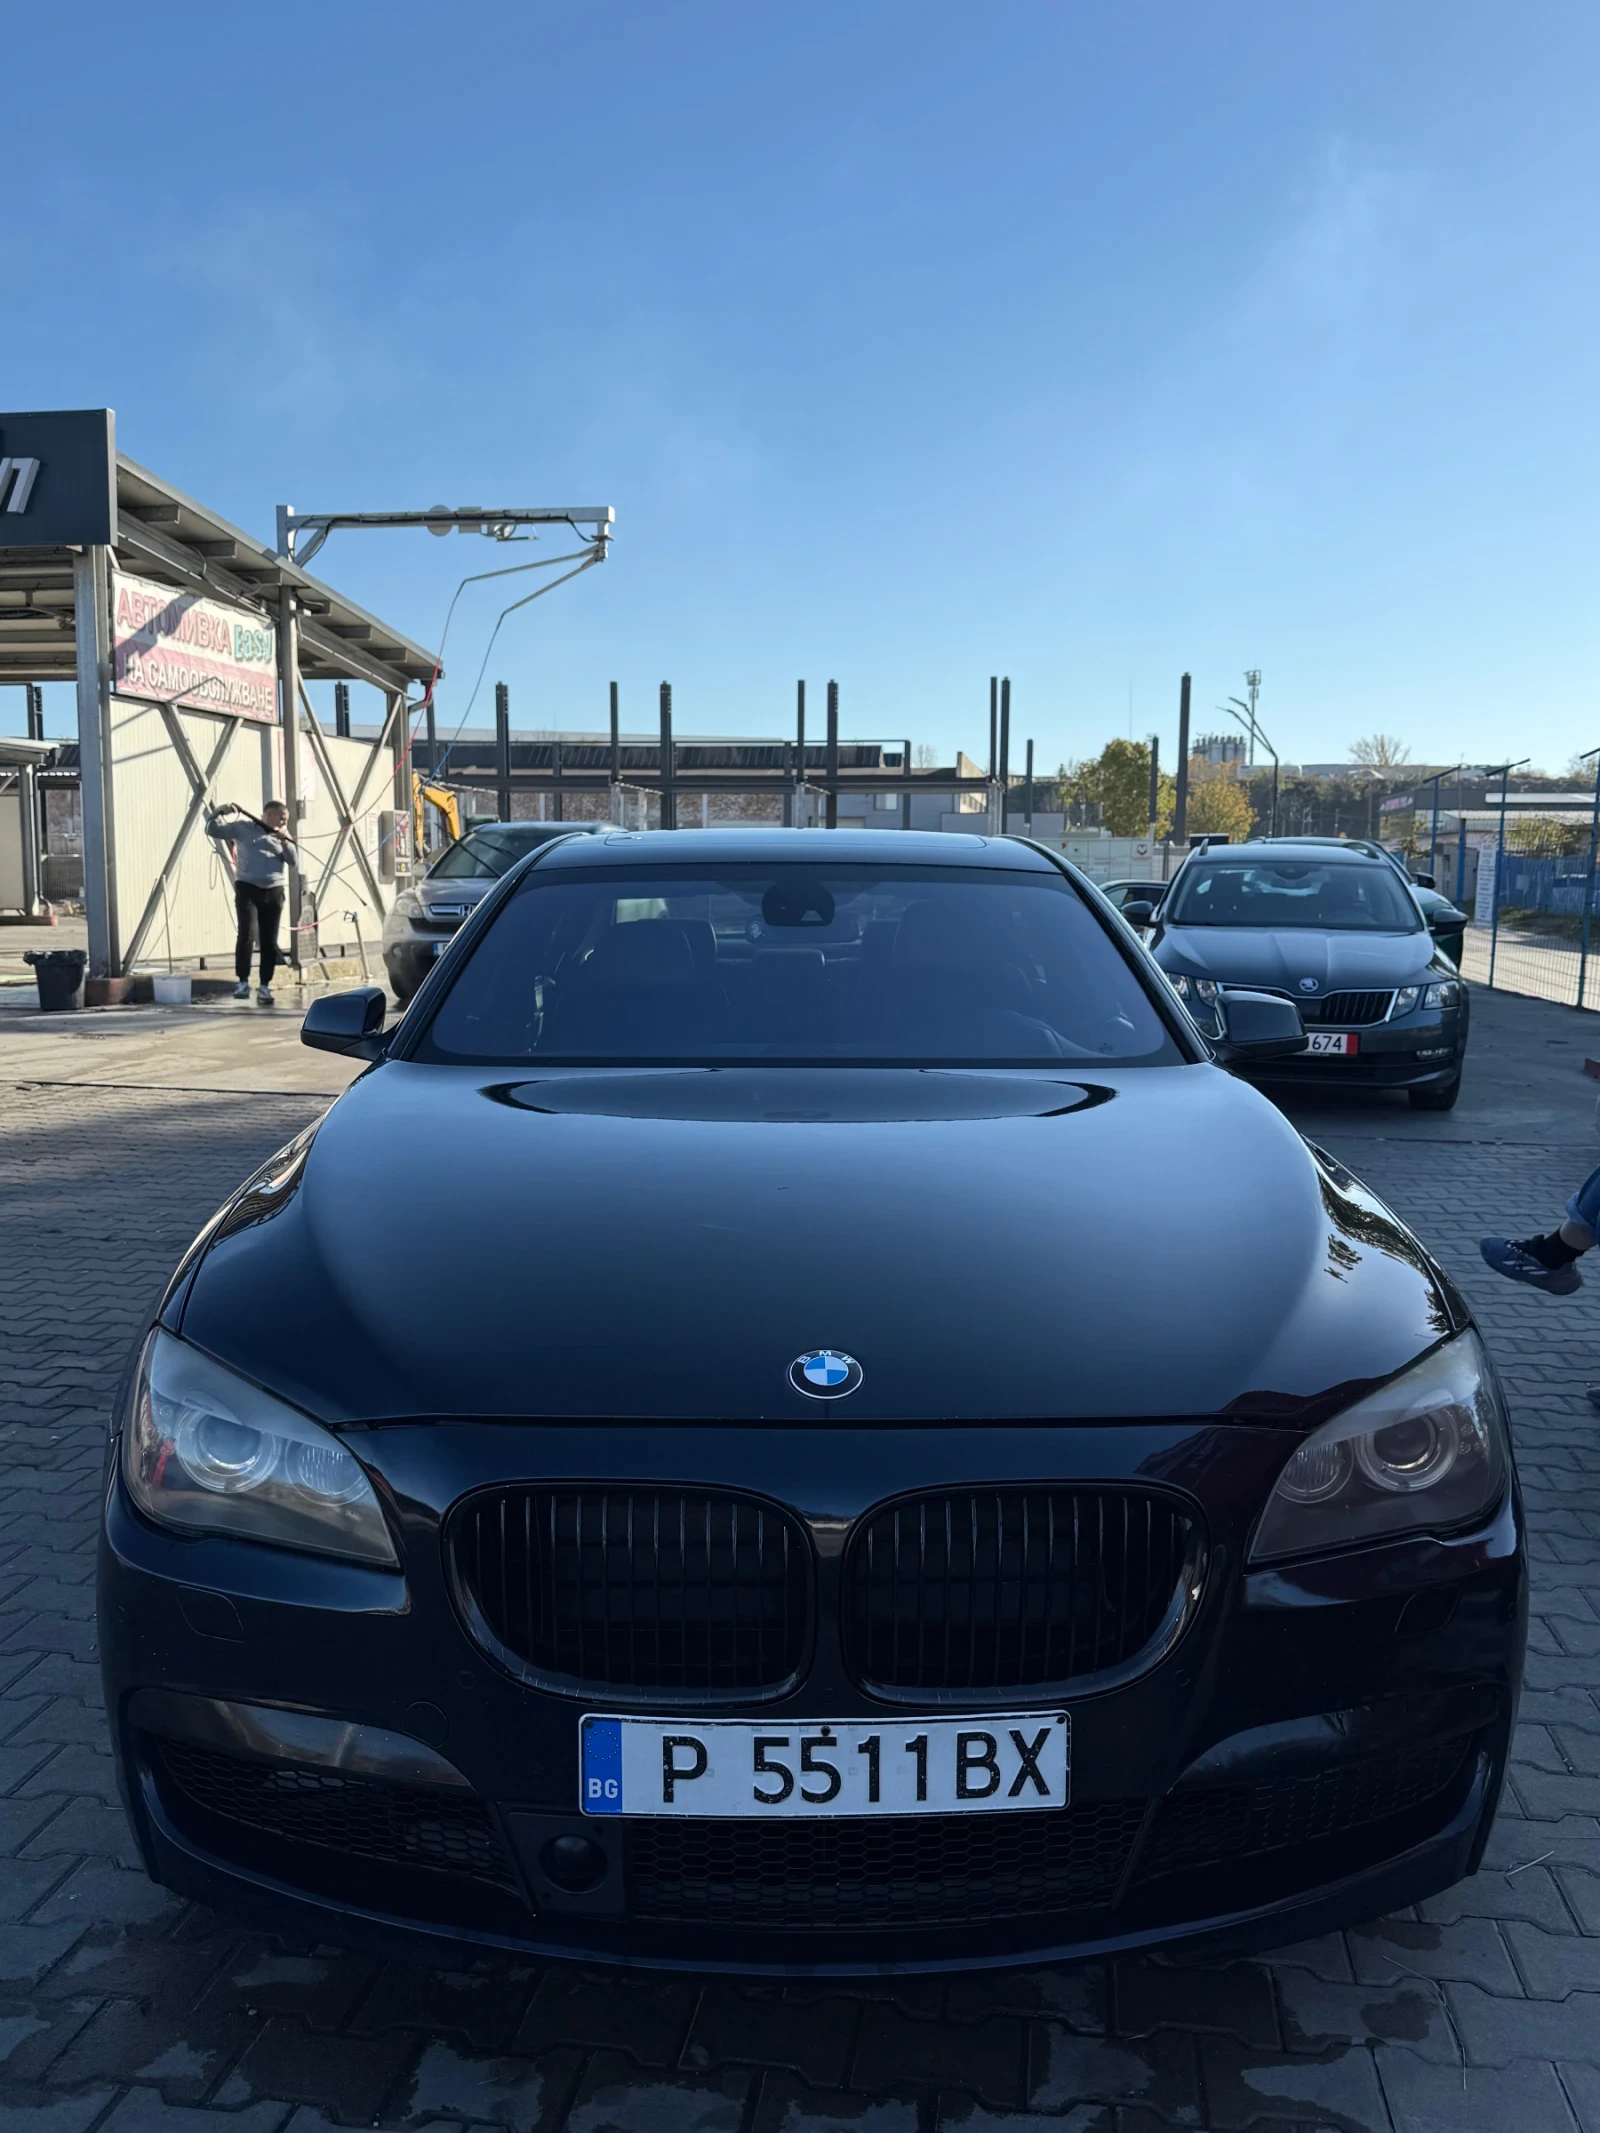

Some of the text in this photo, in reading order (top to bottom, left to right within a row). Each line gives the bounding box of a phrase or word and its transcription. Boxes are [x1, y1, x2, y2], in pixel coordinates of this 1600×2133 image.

[117, 588, 273, 663] АВТОМИВКА Easy
[148, 659, 274, 713] САМООБСЛУЖВАНЕ
[1311, 1034, 1342, 1052] 674
[797, 1350, 856, 1364] BMW
[587, 1778, 619, 1799] BG
